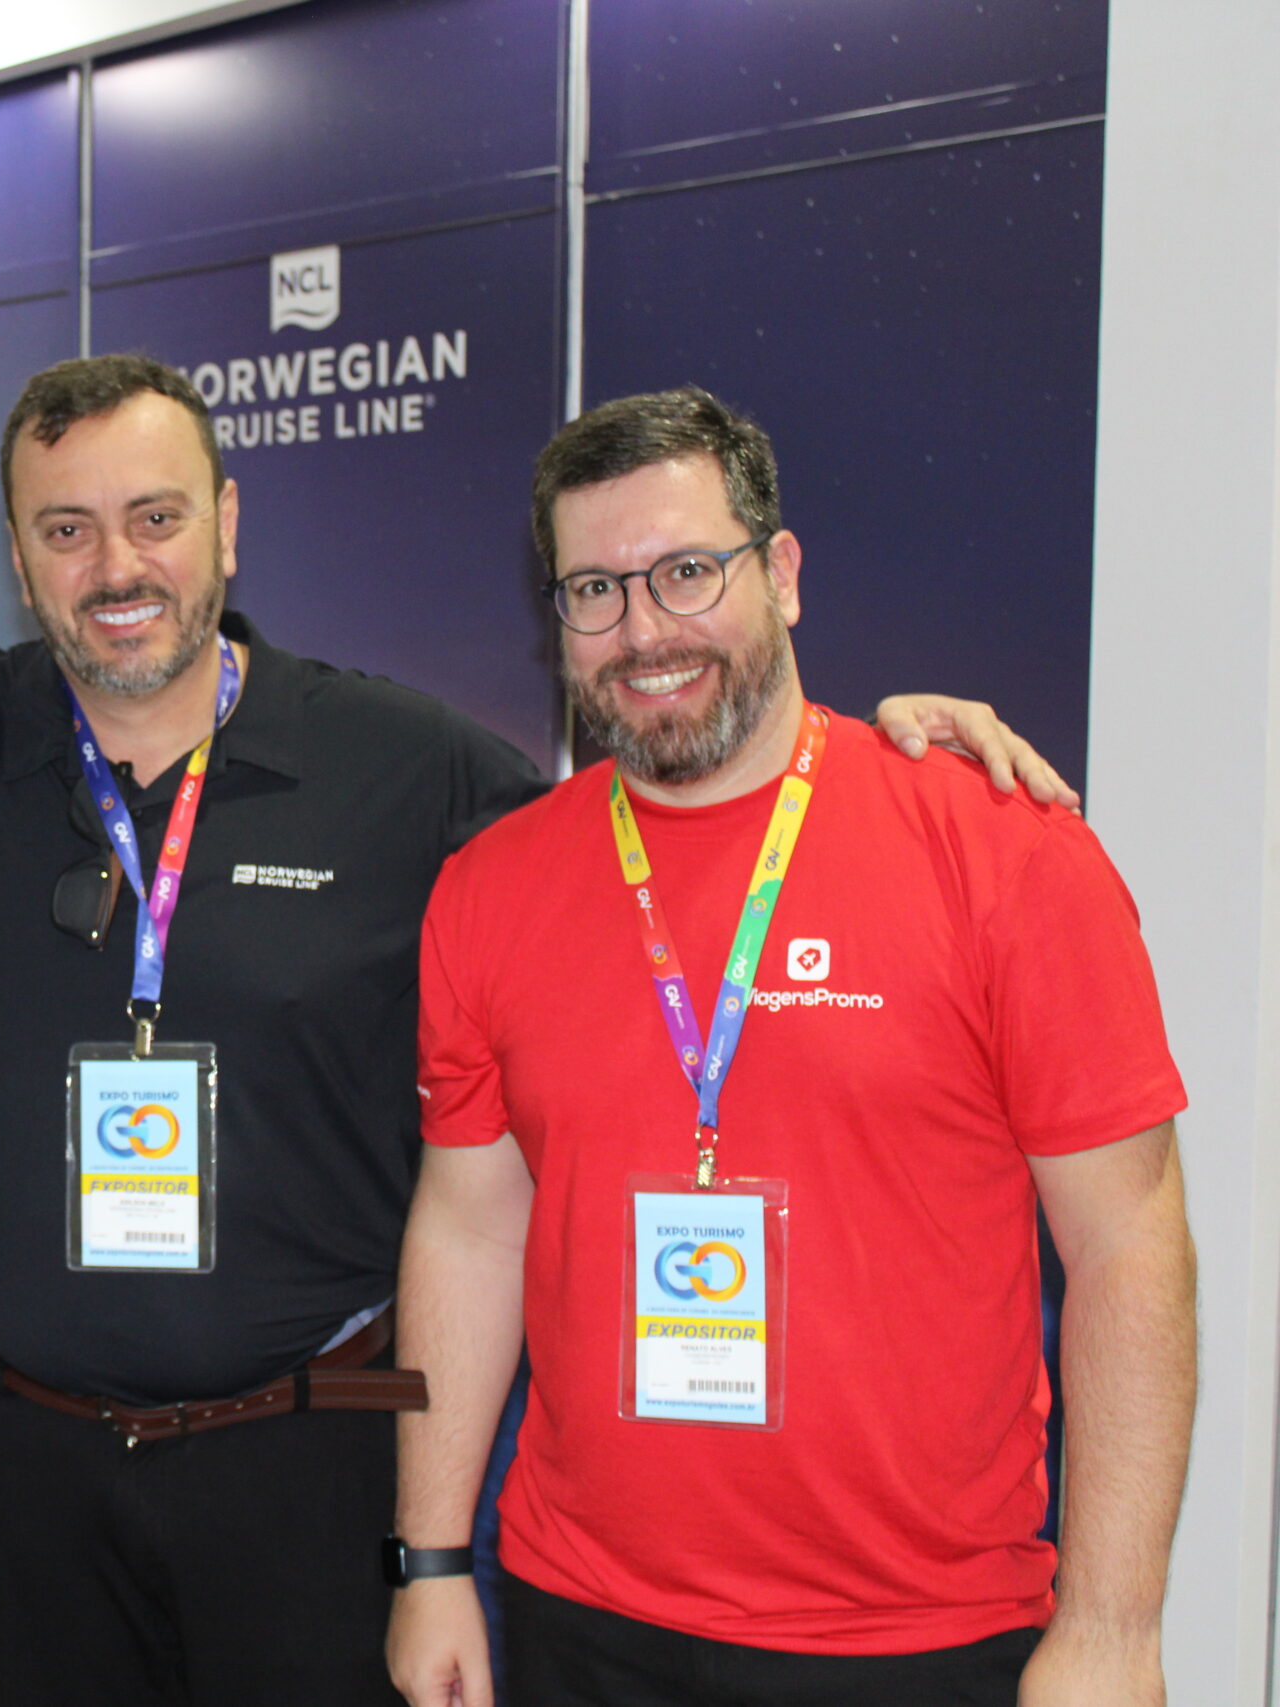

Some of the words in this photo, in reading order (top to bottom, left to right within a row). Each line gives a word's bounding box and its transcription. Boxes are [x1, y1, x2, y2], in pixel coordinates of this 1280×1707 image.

[277, 265, 333, 298] NCL
[179, 329, 468, 409] ORWEGIAN
[214, 406, 321, 449] RUISE
[257, 865, 334, 882] NORWEGIAN
[257, 877, 294, 888] CRUISE
[295, 880, 320, 890] LINE
[100, 1090, 129, 1101] EXPO
[90, 1180, 189, 1195] EXPOSITOR
[657, 1226, 689, 1238] EXPO
[693, 1227, 745, 1240] TURISMO
[646, 1323, 756, 1341] EXPOSITOR
